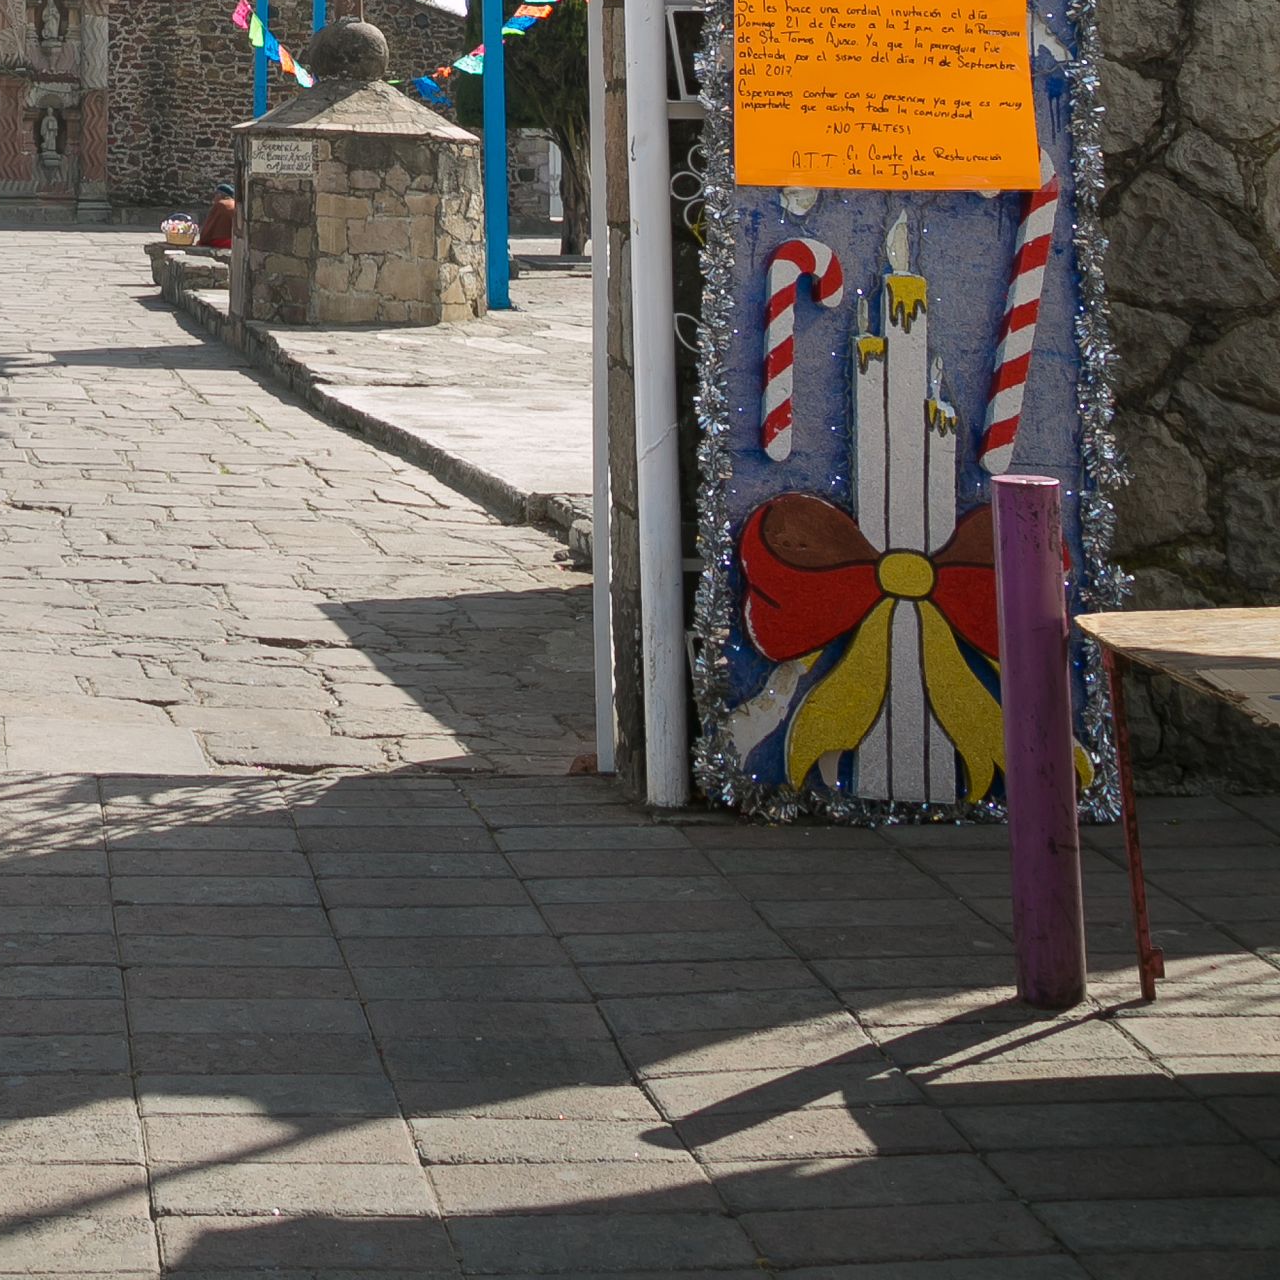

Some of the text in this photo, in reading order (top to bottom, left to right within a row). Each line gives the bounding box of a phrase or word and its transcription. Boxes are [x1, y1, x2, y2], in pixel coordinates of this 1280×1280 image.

[785, 0, 811, 13] hace
[820, 6, 840, 14] una
[846, 4, 881, 16] cordial
[951, 8, 961, 19] el
[735, 13, 775, 31] Domingo
[786, 16, 799, 28] 21
[809, 18, 824, 28] de
[830, 16, 856, 29] Enero
[886, 19, 895, 29] la
[903, 20, 910, 31] 1
[964, 24, 973, 34] la
[737, 33, 751, 44] de
[866, 33, 878, 47] Ya
[887, 41, 903, 51] que
[914, 38, 923, 48] la
[930, 43, 976, 55] parroquia
[984, 41, 1001, 53] fue
[739, 46, 786, 60] afectada
[794, 54, 809, 64] por
[817, 51, 826, 61] el
[835, 54, 862, 62] sismo
[871, 52, 889, 63] del
[923, 56, 934, 65] 19
[939, 57, 952, 68] de
[958, 55, 1016, 71] Septiembre
[739, 63, 755, 76] del
[738, 78, 793, 100] Esperamos
[803, 87, 838, 98] contar
[844, 91, 860, 99] con
[866, 91, 876, 99] su
[881, 94, 925, 107] presencia
[954, 100, 971, 109] que
[999, 101, 1022, 110] muy
[741, 98, 791, 112] importante
[801, 104, 817, 114] que
[826, 101, 855, 113] asista
[897, 104, 907, 115] la
[914, 109, 974, 120] comunidad
[912, 149, 926, 161] de
[848, 162, 935, 180] de la Iglesia
